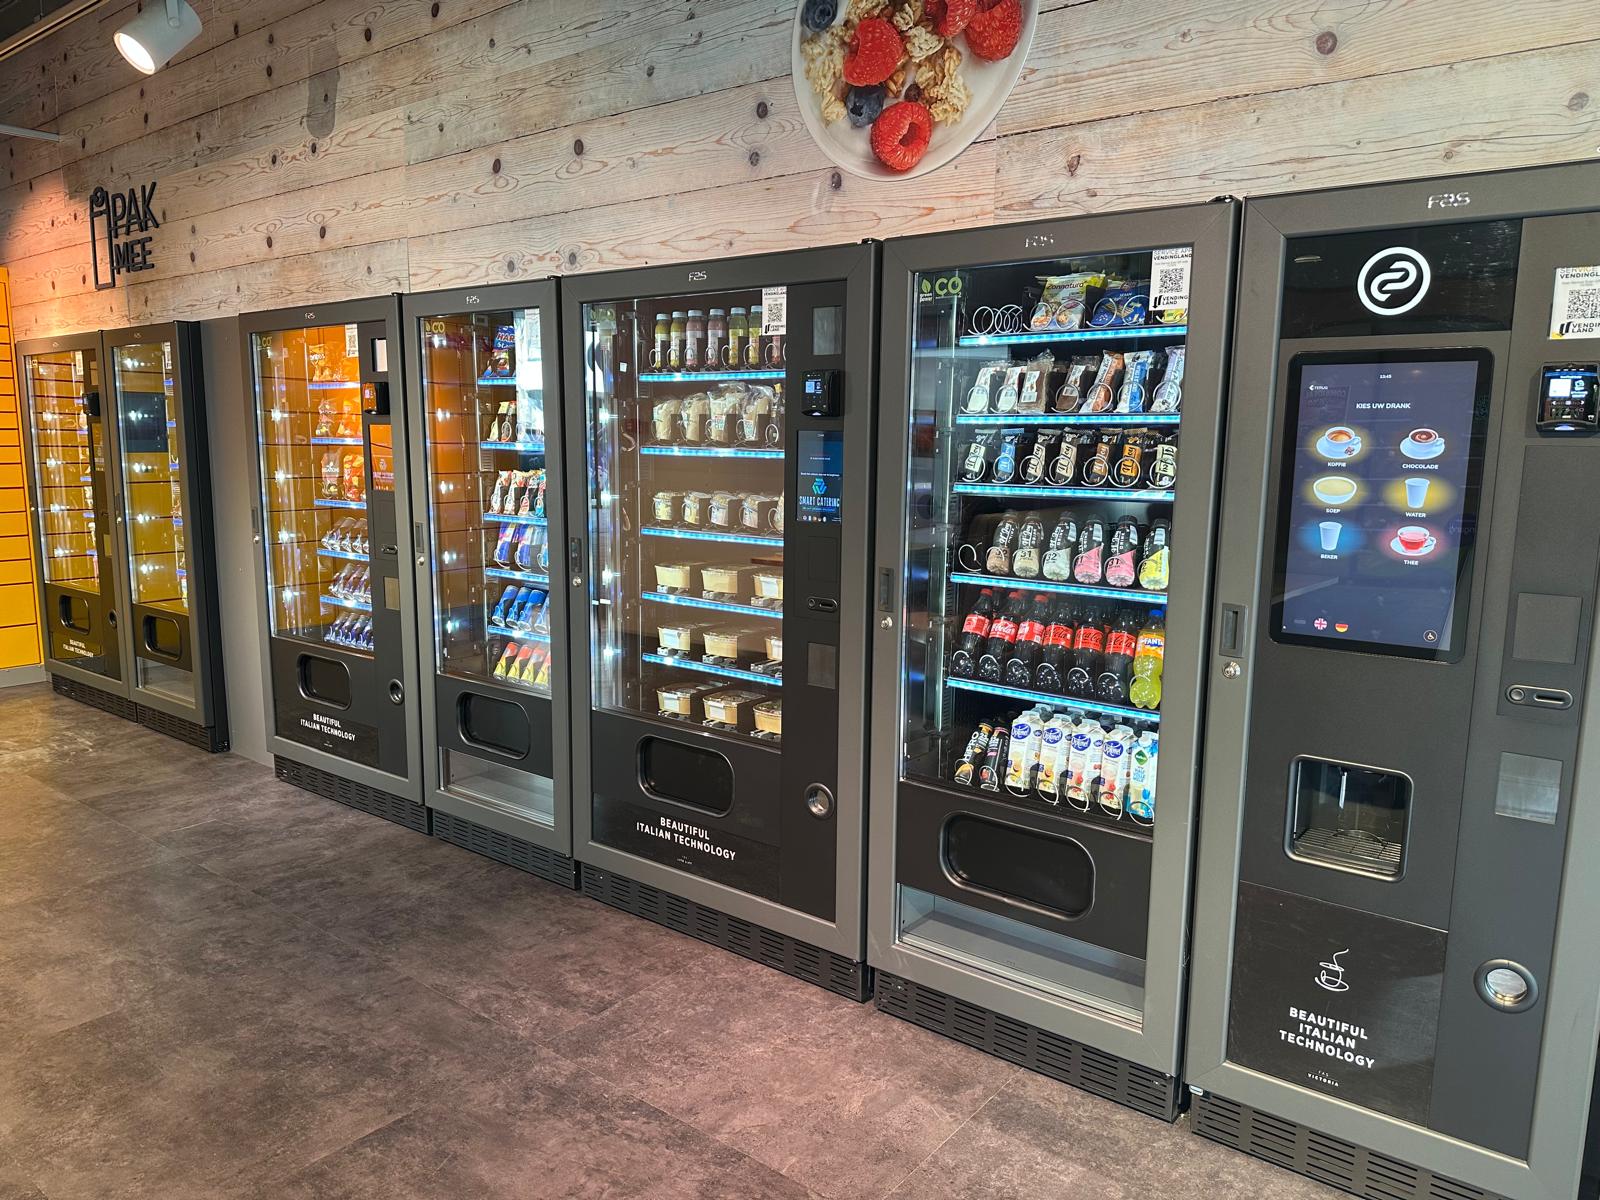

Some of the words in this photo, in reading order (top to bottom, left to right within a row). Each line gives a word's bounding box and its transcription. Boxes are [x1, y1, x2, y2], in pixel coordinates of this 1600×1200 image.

[111, 182, 160, 238] PAK
[115, 237, 154, 274] MEE
[817, 497, 840, 507] CATERING
[301, 719, 320, 731] ITALIAN
[321, 725, 355, 741] TECHNOLOGY
[313, 714, 341, 727] BEAUTIFUL
[637, 822, 670, 841] ITALIAN
[674, 834, 735, 860] TECHNOLOGY
[660, 816, 709, 840] BEAUTIFUL
[1290, 1007, 1368, 1039] BEAUTIFUL
[1299, 1023, 1355, 1049] ITALIAN
[1279, 1030, 1375, 1069] TECHNOLOGY
[1307, 1073, 1339, 1087] VICTORIA
